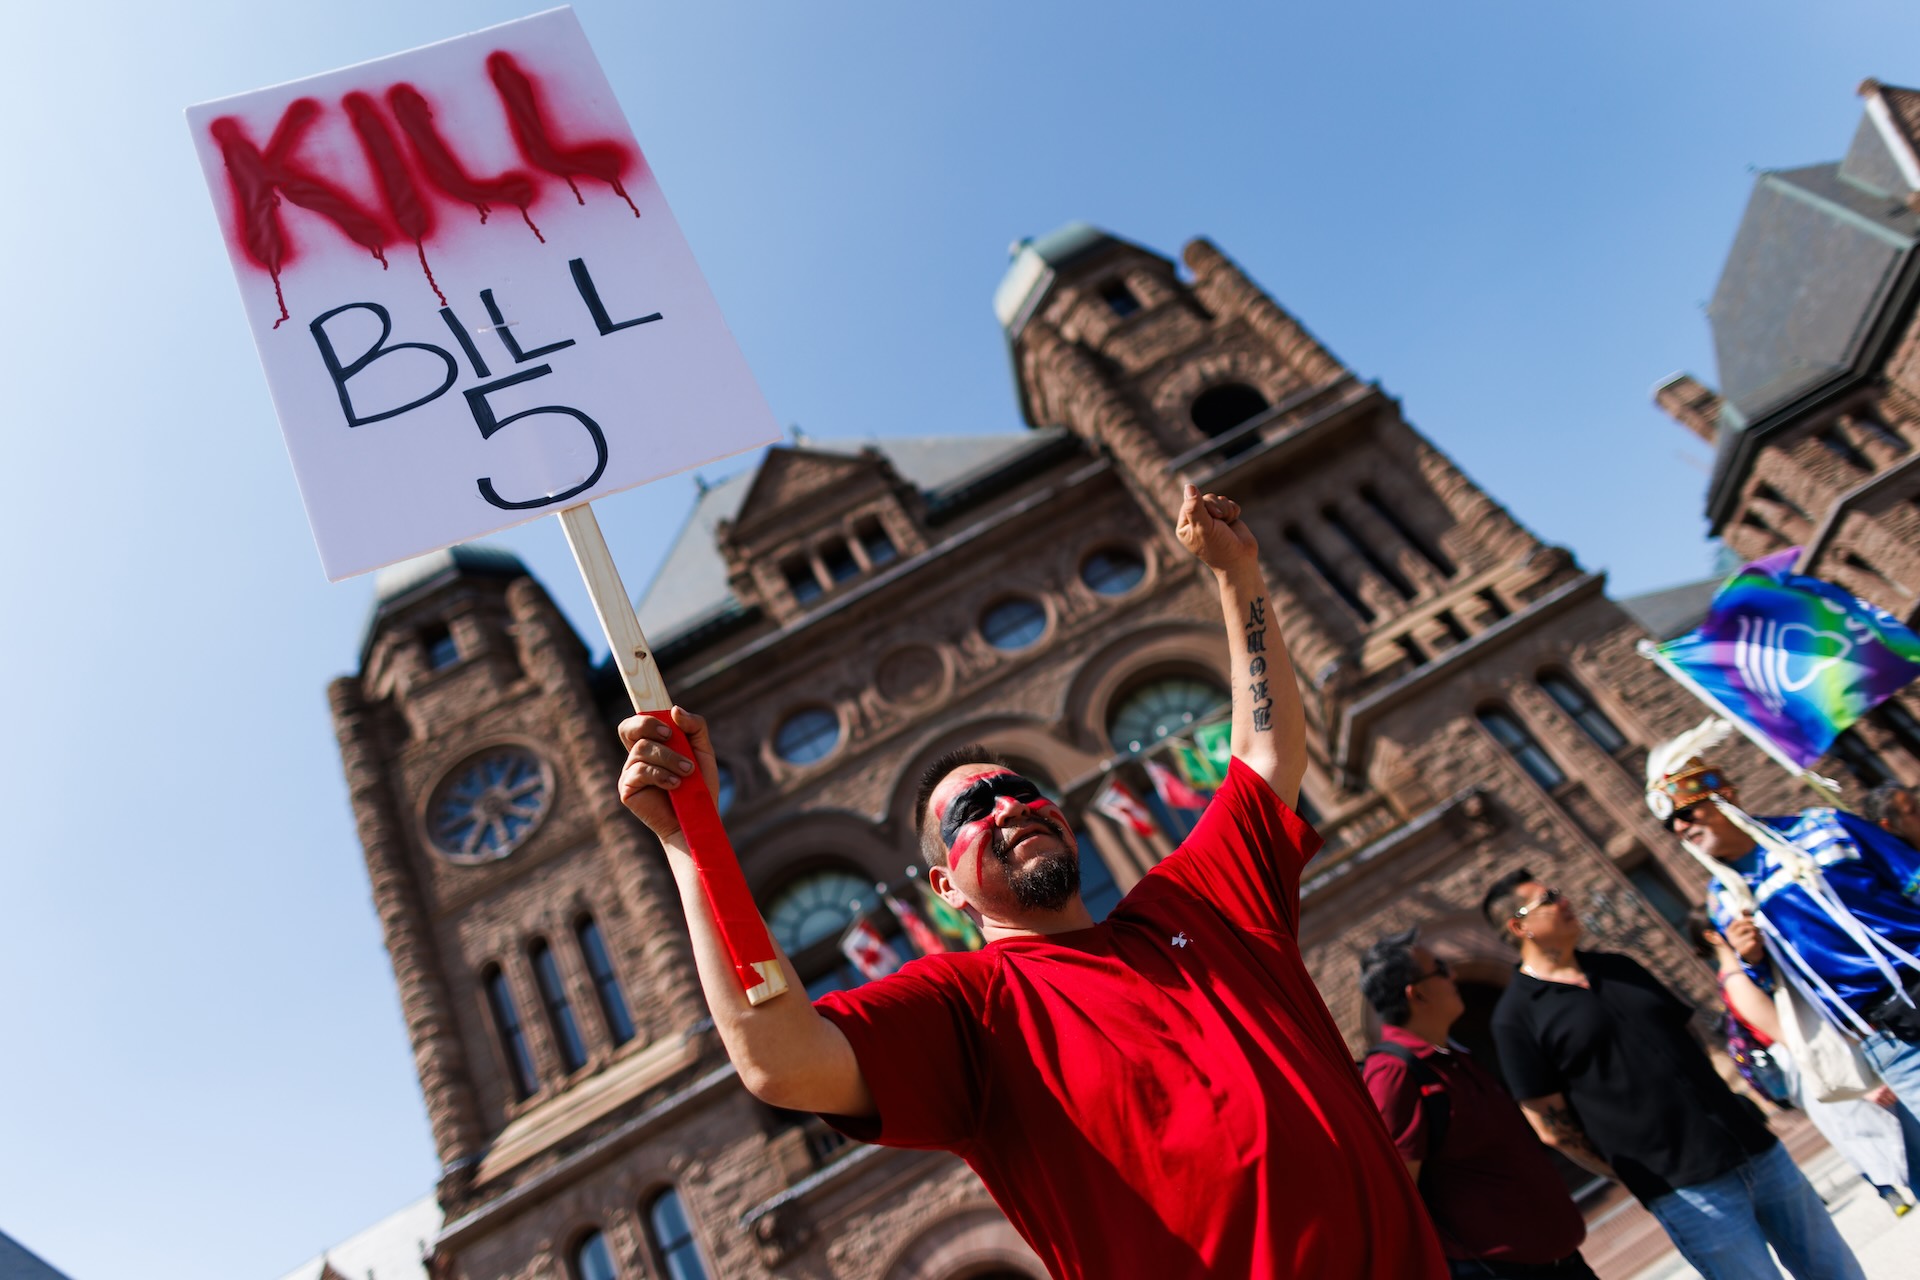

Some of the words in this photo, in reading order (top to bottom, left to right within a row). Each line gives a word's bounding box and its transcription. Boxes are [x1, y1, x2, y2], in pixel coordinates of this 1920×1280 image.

[208, 49, 633, 275] KILL
[309, 257, 663, 427] BILL
[462, 363, 609, 511] 5
